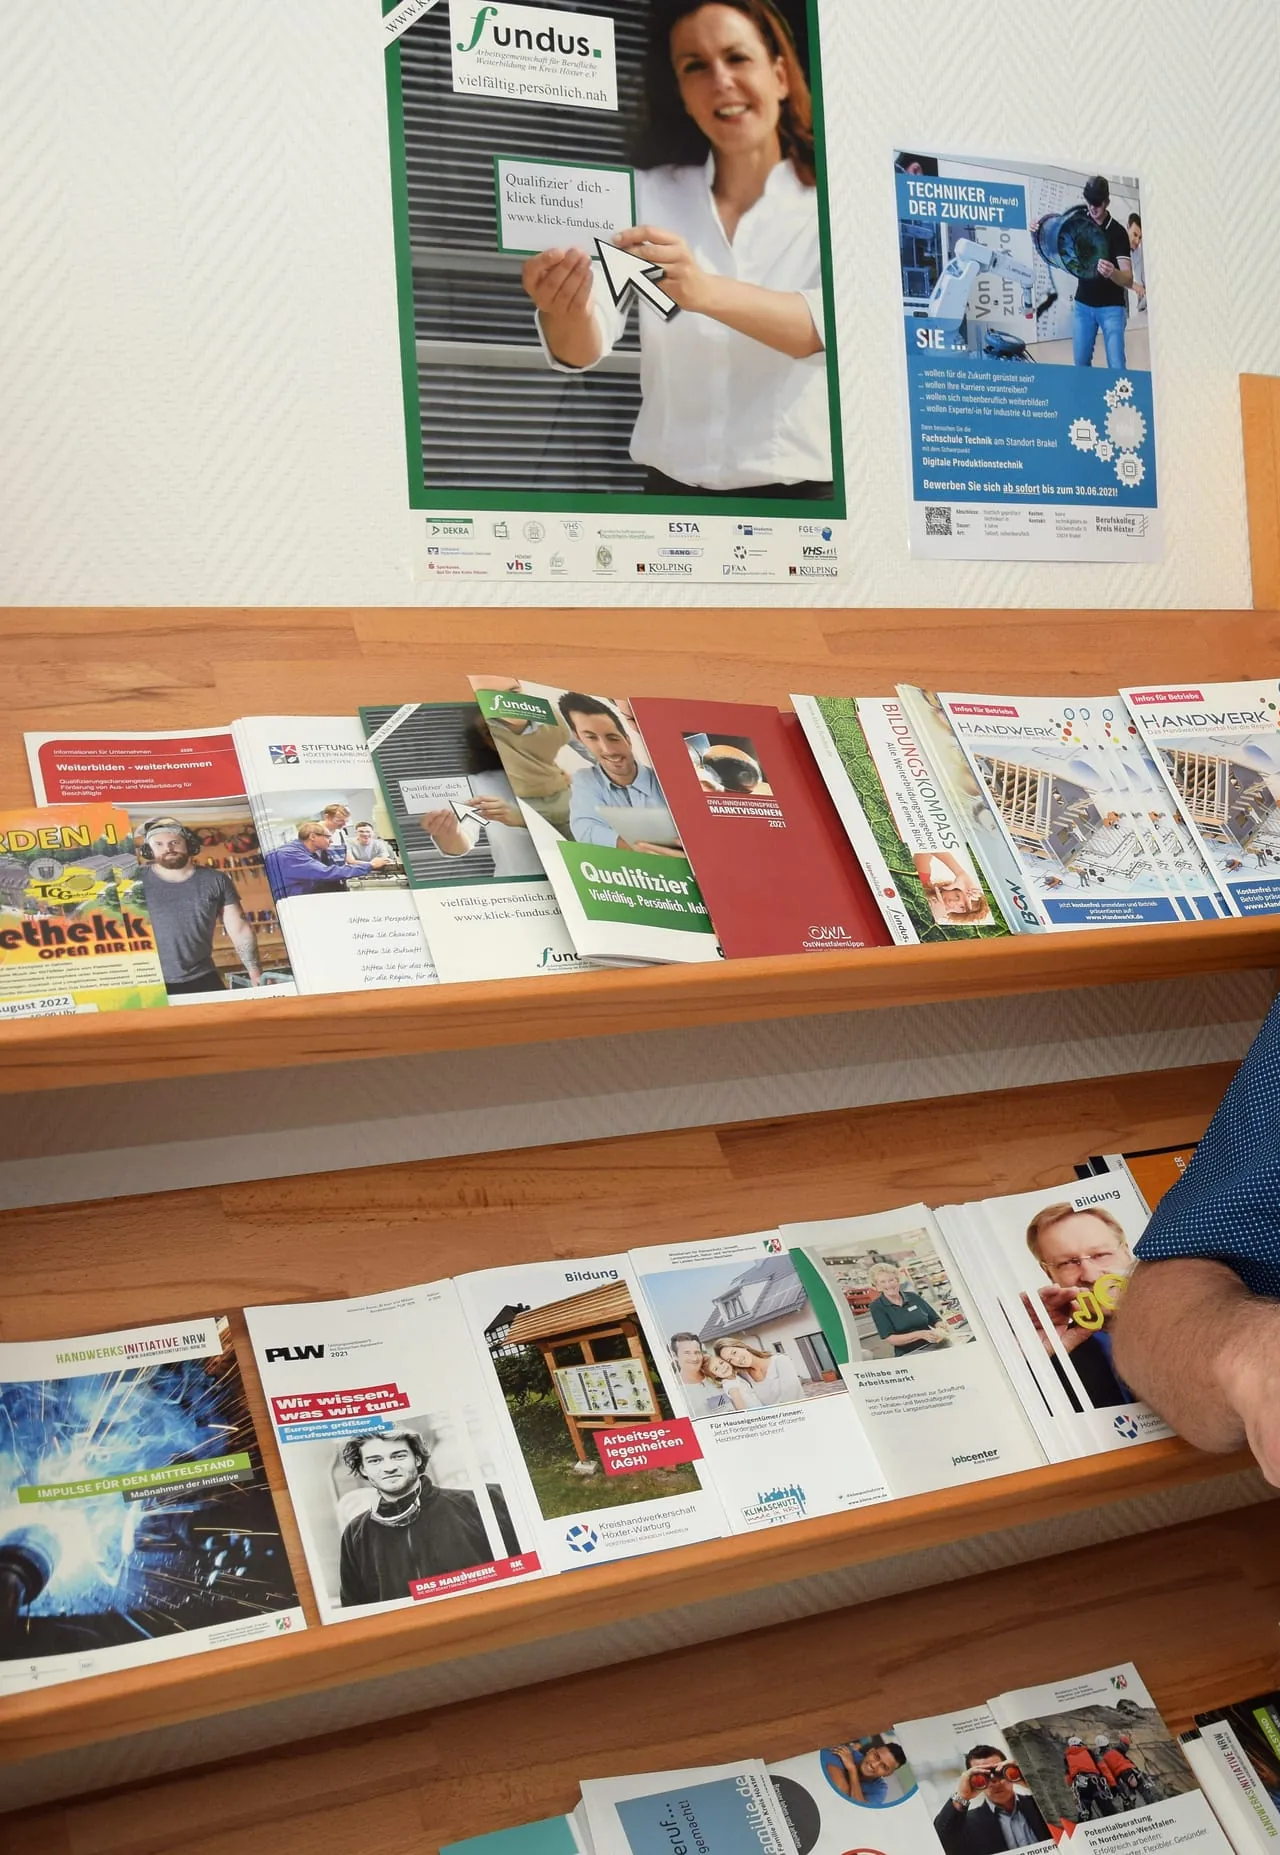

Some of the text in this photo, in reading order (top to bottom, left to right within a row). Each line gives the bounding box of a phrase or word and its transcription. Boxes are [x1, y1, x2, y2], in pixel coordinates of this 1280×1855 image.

[458, 76, 608, 102] vielfältig.persönlich.nah
[577, 180, 602, 194] dich
[907, 181, 1019, 208] TECHNIKER (m/w/d)
[506, 191, 584, 208] klick fundus!
[909, 200, 1004, 223] DER ZUKUNFT
[507, 213, 615, 230] www.klick-fundus.de
[916, 328, 945, 349] SIE
[924, 370, 991, 380] wollen Zukunft
[925, 381, 946, 389] wollen
[926, 393, 947, 401] wollen
[926, 405, 947, 413] wollen
[921, 434, 1035, 447] Fachschule Technik Standort
[922, 457, 1024, 469] Digitale Produktionstechnik
[923, 480, 1118, 497] Bewerben Sie sich sofort bis zum 30.06.2021!
[669, 522, 700, 533] ESTA
[1096, 516, 1136, 526] Berufskolleg
[1096, 525, 1112, 533] Kreis
[443, 527, 470, 535] DEKRA
[507, 560, 533, 571] vhs
[649, 563, 693, 574] KOLPING
[799, 566, 838, 577] KOLPING
[489, 694, 547, 715] fundus.
[1167, 692, 1200, 701] Betriebe
[1139, 711, 1270, 729] HANDWERK
[957, 722, 1057, 737] HANDWERK
[301, 744, 354, 752] STIFTUNG
[56, 760, 213, 772] Weiterbilden weiterkommen
[882, 703, 960, 850] BILDUNGSKOMPASS
[885, 741, 938, 850] Alle Weiterbildungsangebote
[709, 805, 783, 818] MARKTVISIONEN
[768, 819, 786, 829] 2021
[899, 804, 928, 851] einen Blick!
[1236, 886, 1272, 896] Kostenfrei
[589, 888, 689, 914] Vielfältig. Persönlich.
[38, 941, 88, 960] OPEN
[802, 940, 865, 949] OstWestfalenLippe
[40, 997, 70, 1008] 2022
[1074, 1189, 1121, 1208] Bildung
[564, 1267, 619, 1283] Bildung
[56, 1333, 207, 1365] HANDWERKSINITIATIVE NRW
[265, 1344, 324, 1363] PLW
[854, 1370, 892, 1380] Teilhabe
[858, 1375, 916, 1388] Arbeitsmarkt
[276, 1389, 395, 1410] Wir wissen,
[279, 1399, 405, 1422] was wir tun.
[284, 1419, 372, 1434] Europas größter
[285, 1425, 386, 1441] Berufswettbewerb
[603, 1428, 671, 1446] Arbeitsge-
[606, 1437, 684, 1458] legenheiten
[610, 1454, 648, 1470] (AGH)
[952, 1449, 998, 1467] jobcenter
[37, 1458, 235, 1500] IMPULSE FÜR DEN MITTELSTAND
[130, 1473, 239, 1499] Maßnahmen der Initiative
[744, 1497, 798, 1517] KLIMASCHUTZ
[598, 1505, 697, 1530] Kreishandwerkerschaft
[415, 1582, 437, 1592] DAS
[439, 1567, 496, 1586] HANDWERK
[1084, 1814, 1154, 1838] Potentialberatung
[1099, 1817, 1178, 1845] Nordrhein-Westfalen.
[1093, 1840, 1132, 1855] Erfolgreich
[1143, 1828, 1209, 1854] Flexibler. Gesünder.
